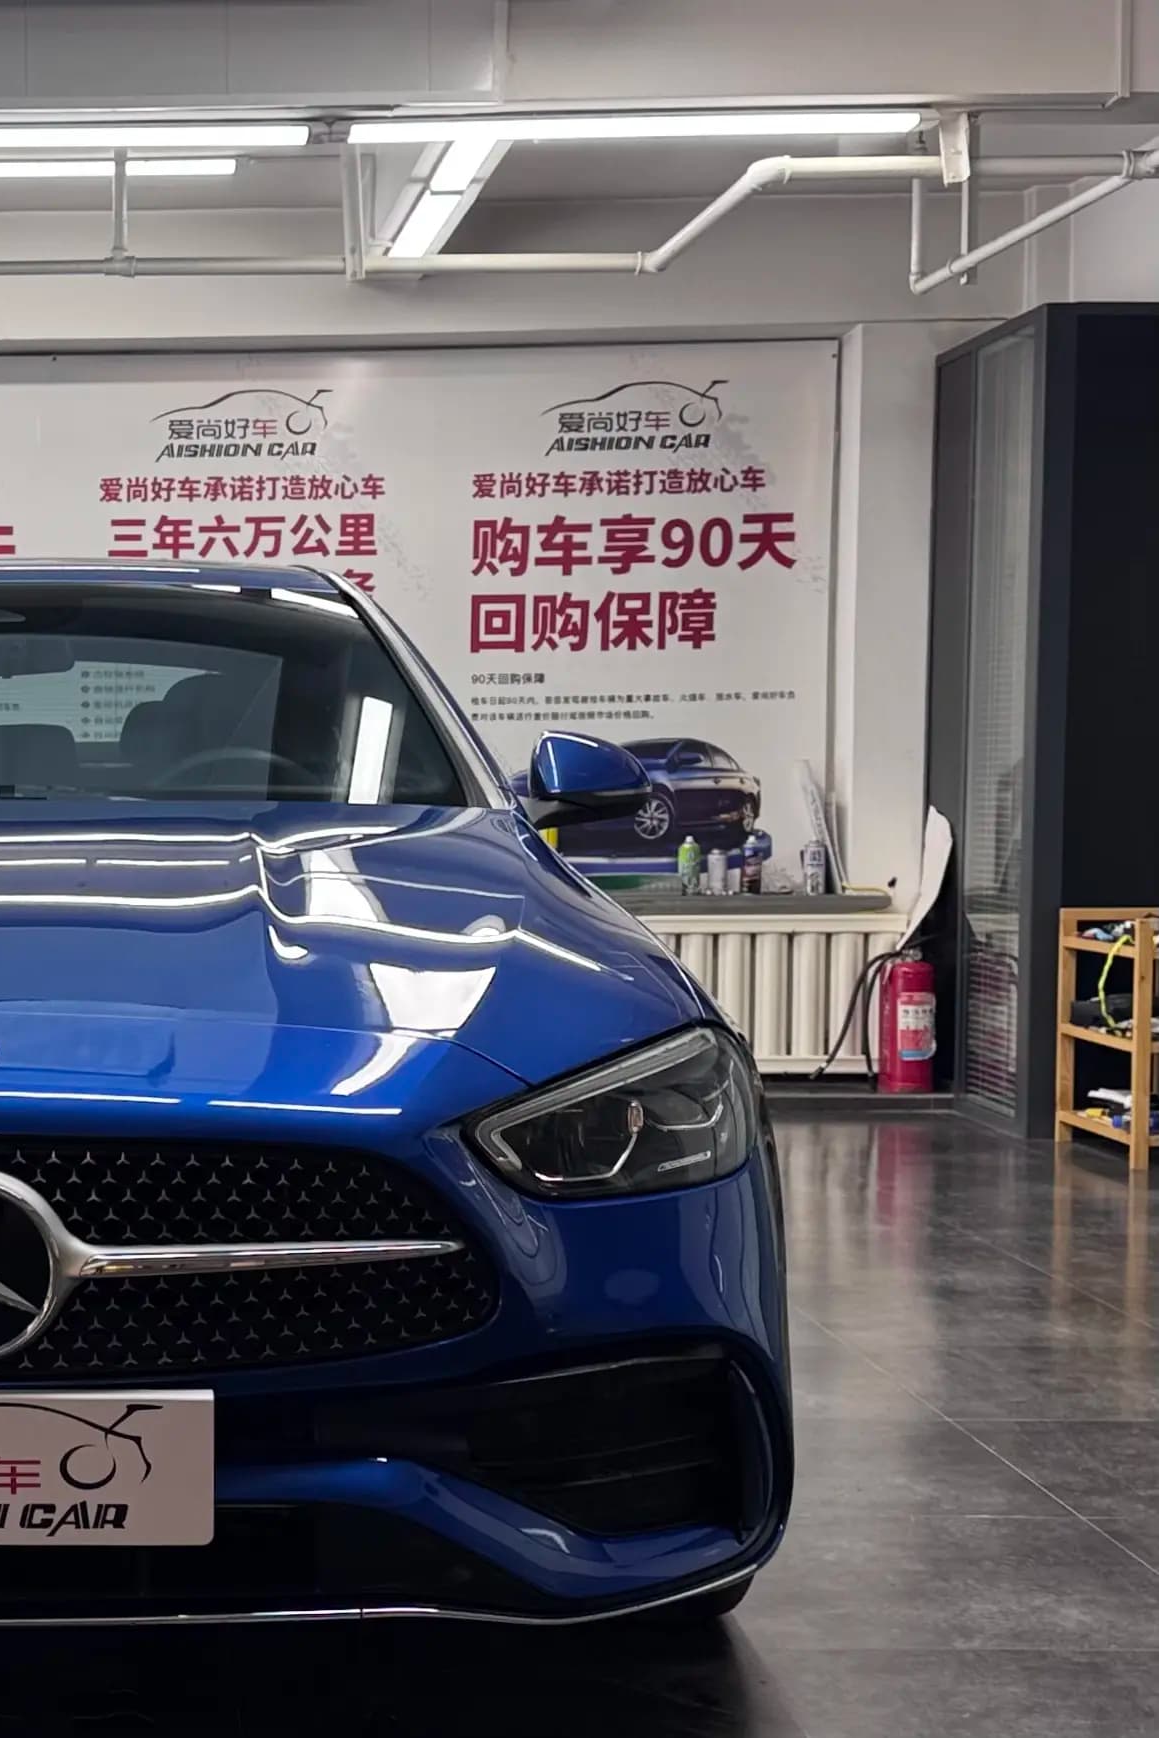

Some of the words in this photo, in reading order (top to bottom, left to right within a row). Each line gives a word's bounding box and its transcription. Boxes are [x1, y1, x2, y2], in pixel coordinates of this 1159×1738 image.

[169, 418, 277, 440] 爱尚好车
[558, 411, 670, 433] 爱尚好车
[156, 443, 262, 462] AISHION
[267, 441, 316, 460] CAR
[545, 435, 654, 456] AISHION
[659, 433, 711, 453] CAR
[100, 474, 385, 502] 爱尚好车承诺打造放心车
[473, 466, 766, 498] 爱尚好车承诺打造放心车
[108, 513, 377, 559] 三年六万公里
[472, 513, 796, 576] 购车享90天
[471, 588, 716, 653] 回购保障
[470, 673, 545, 685] 90天回购保障
[19, 1501, 128, 1536] CAR
